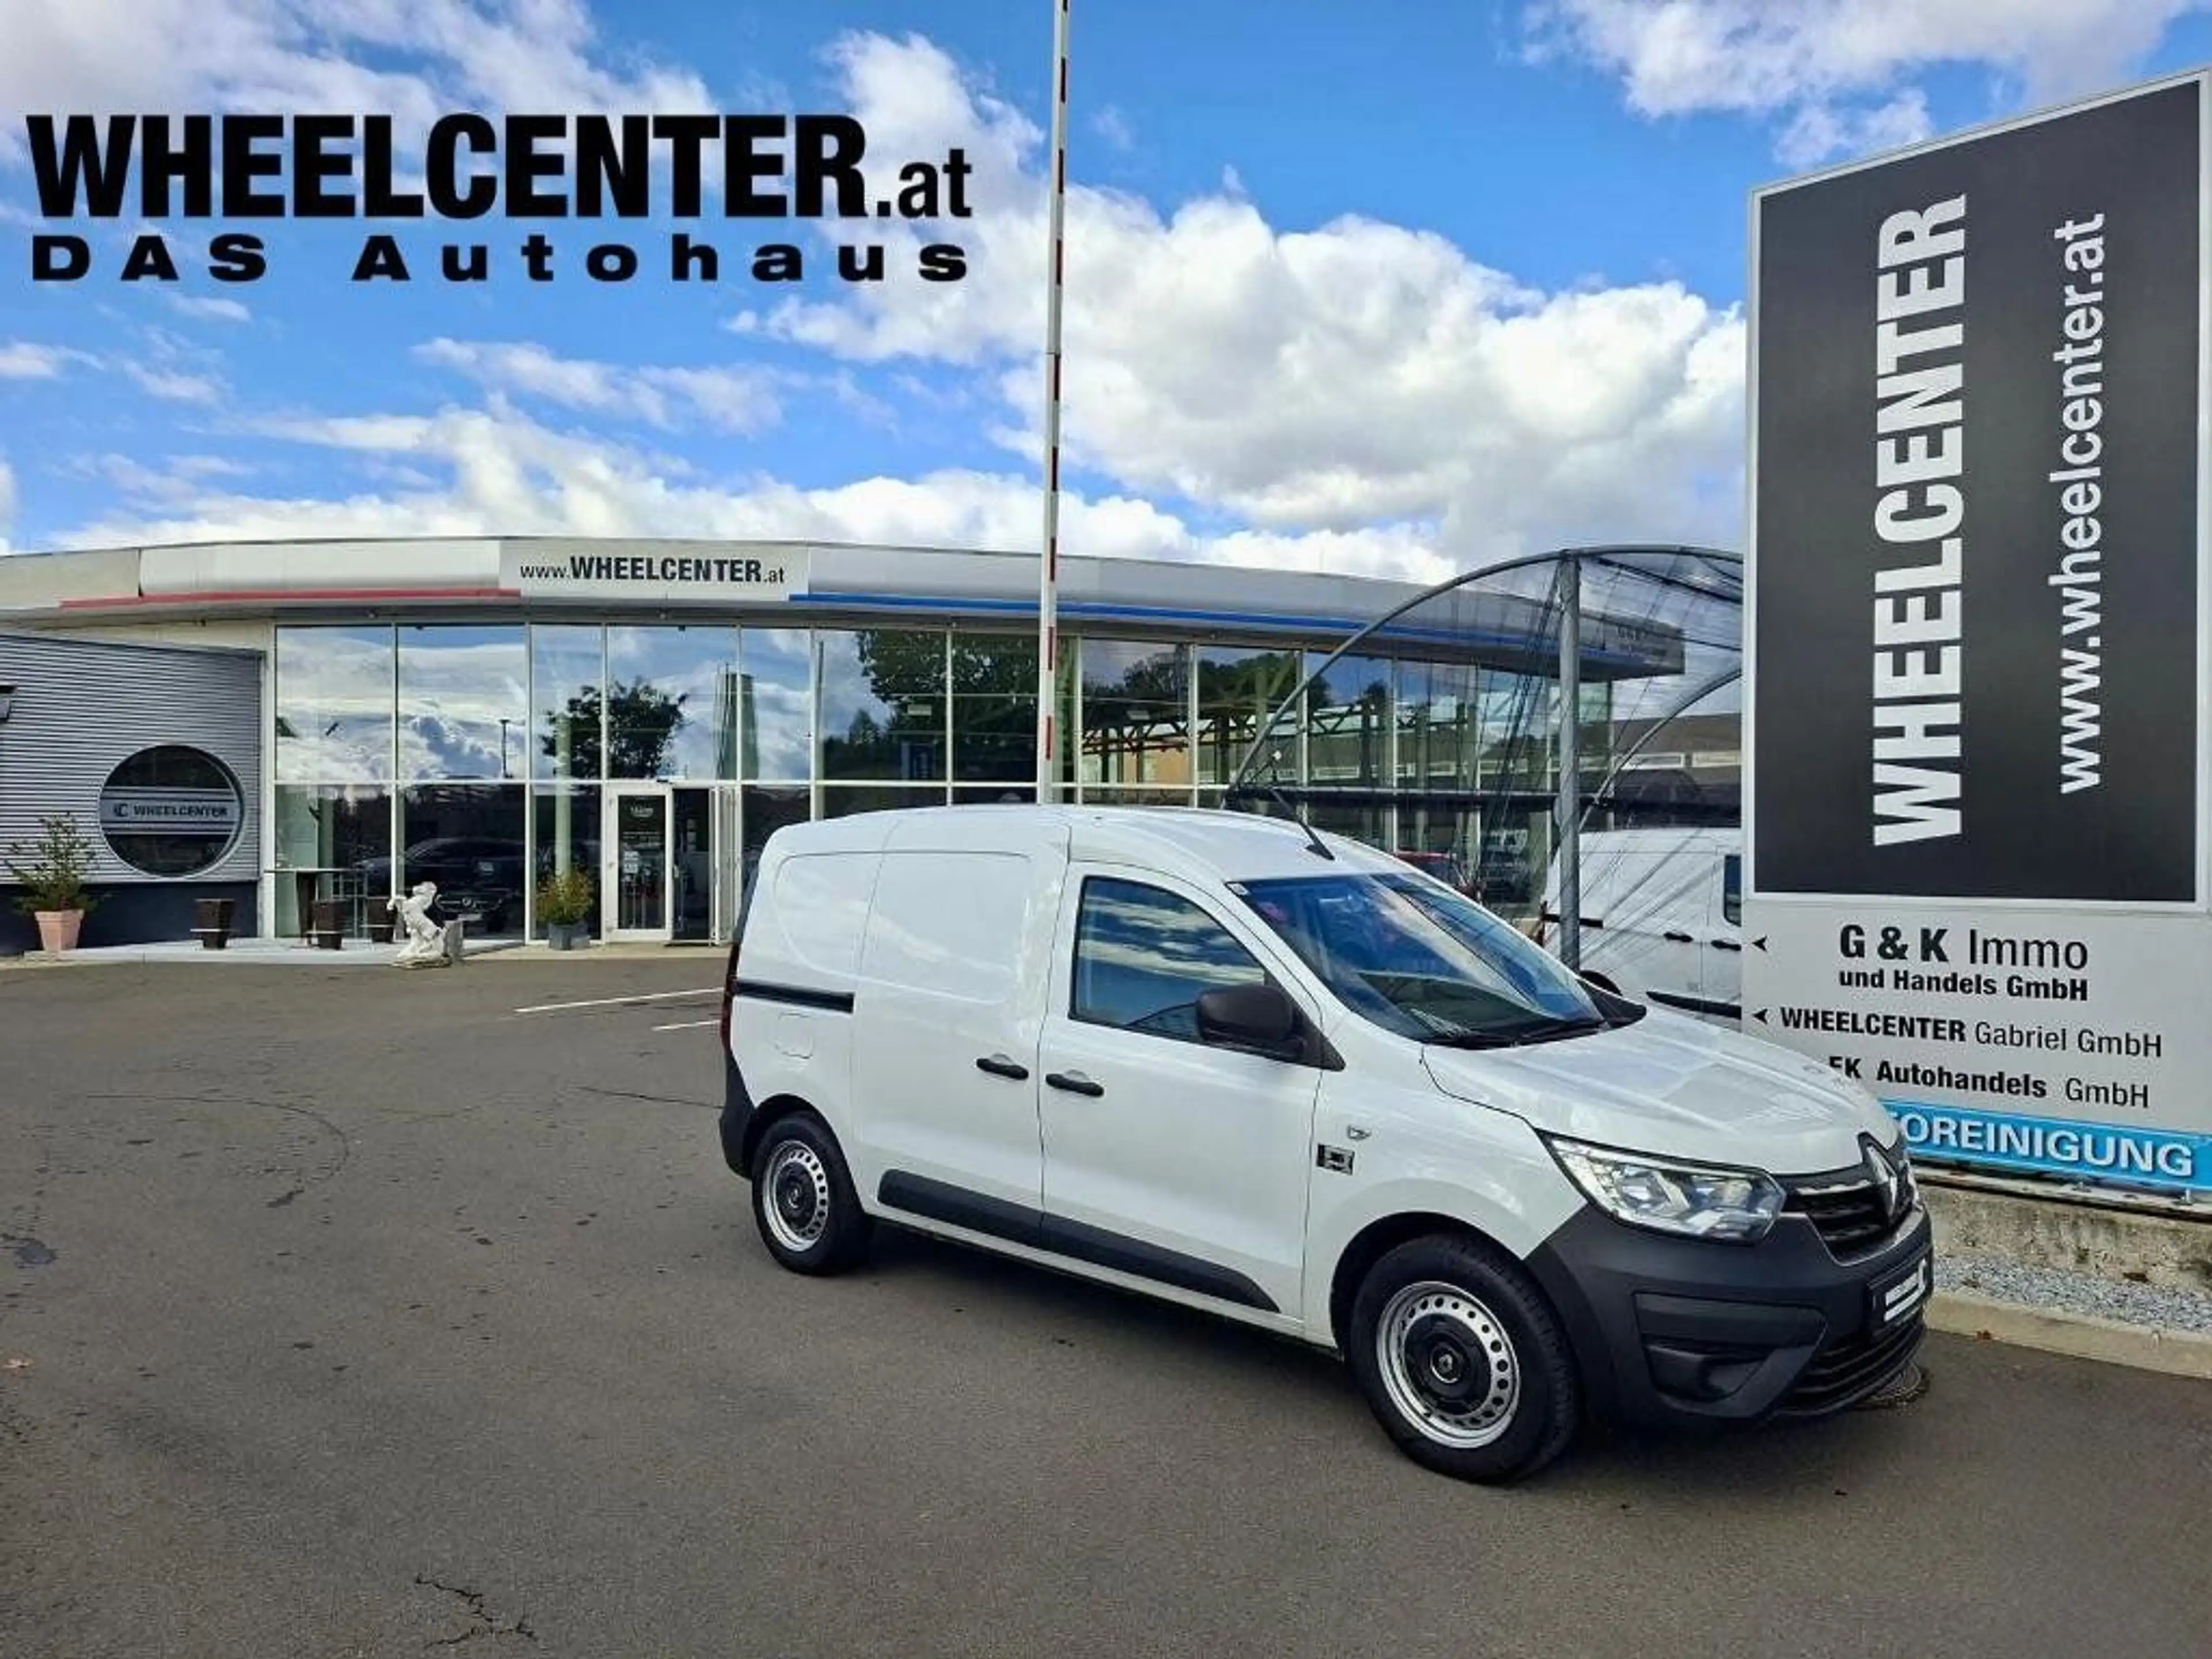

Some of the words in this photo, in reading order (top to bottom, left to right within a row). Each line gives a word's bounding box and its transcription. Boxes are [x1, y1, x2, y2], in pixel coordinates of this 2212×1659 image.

[1873, 194, 1967, 846] WHEELCENTER
[2048, 213, 2105, 794] www.wheelcenter.at
[520, 555, 785, 584] www.WHEELCENTER.at
[134, 805, 228, 817] WHEELCENTER
[1840, 925, 1865, 959] G
[1877, 926, 1908, 960] &
[1920, 927, 1950, 963] K
[1969, 929, 2088, 970] Immo
[1839, 968, 1885, 988] und
[1893, 969, 1997, 995] Handels
[2006, 977, 2088, 1001] GmbH
[1780, 1006, 1966, 1042] WHEELCENTER
[1975, 1021, 2067, 1051] Gabriel
[2077, 1028, 2162, 1058] GmbH
[1876, 1060, 2047, 1099] Autohandels
[2065, 1077, 2149, 1109] GmbH
